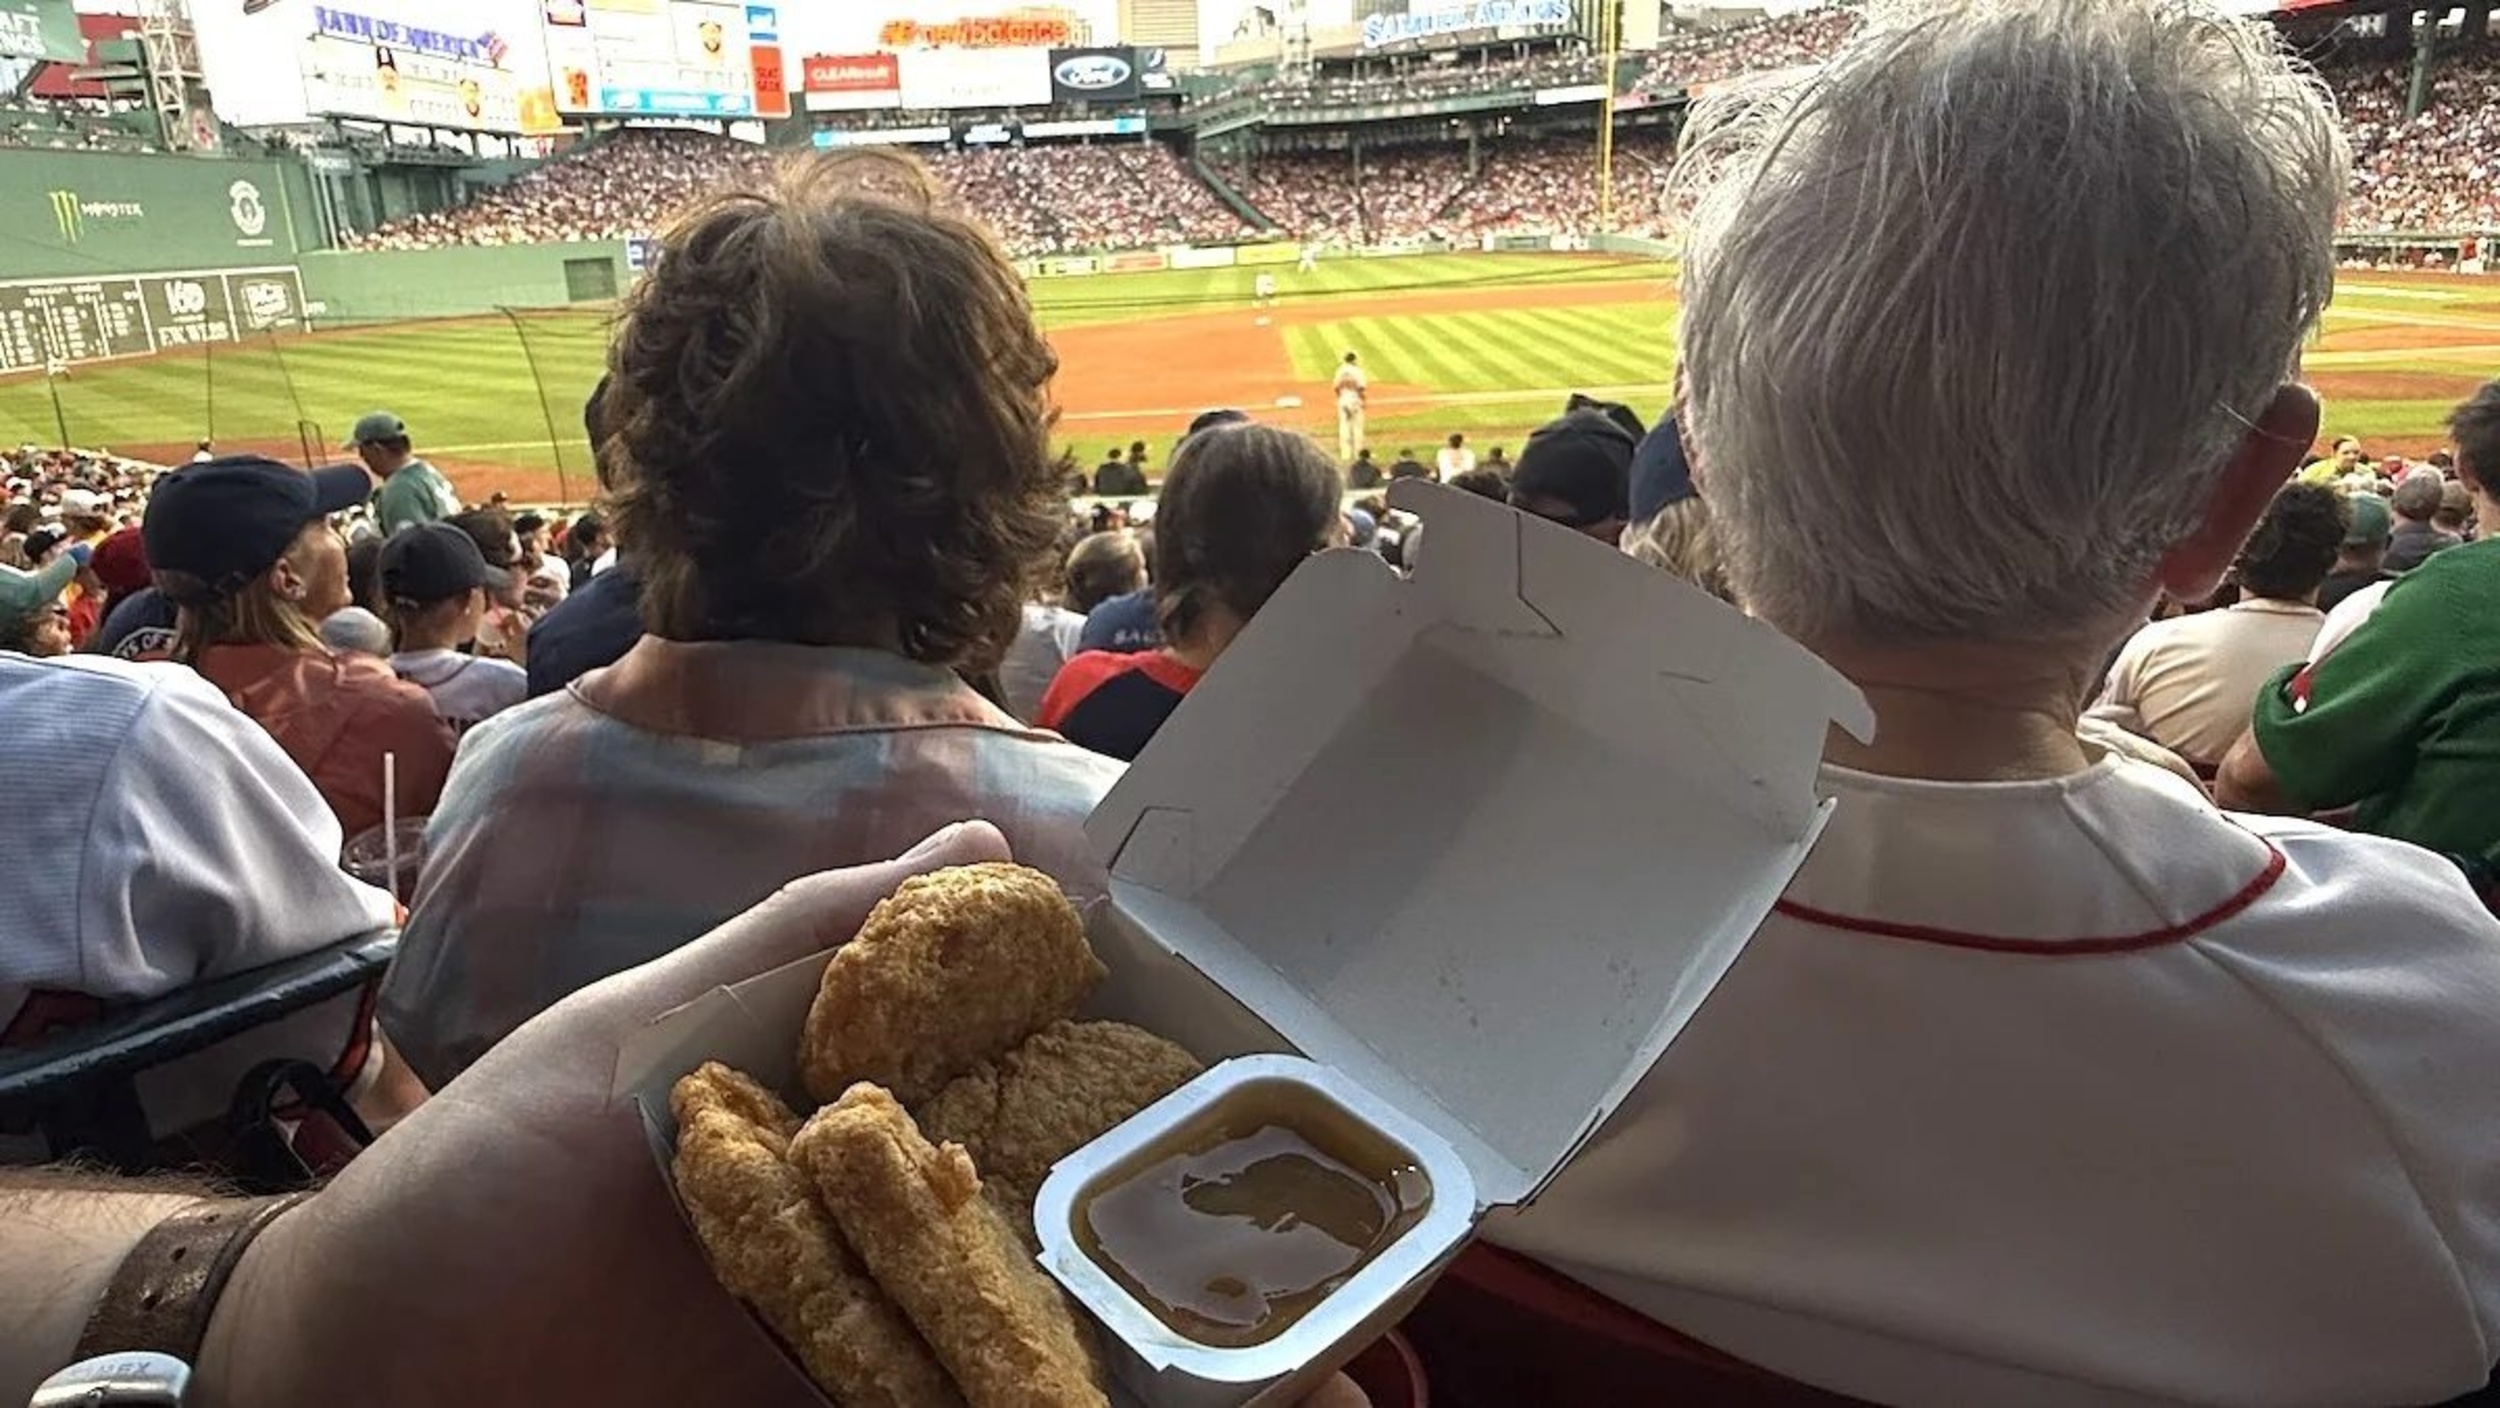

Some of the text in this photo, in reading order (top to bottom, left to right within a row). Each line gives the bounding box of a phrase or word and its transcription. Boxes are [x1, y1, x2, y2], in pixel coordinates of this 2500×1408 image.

[315, 5, 480, 58] BANK OF AMERICA
